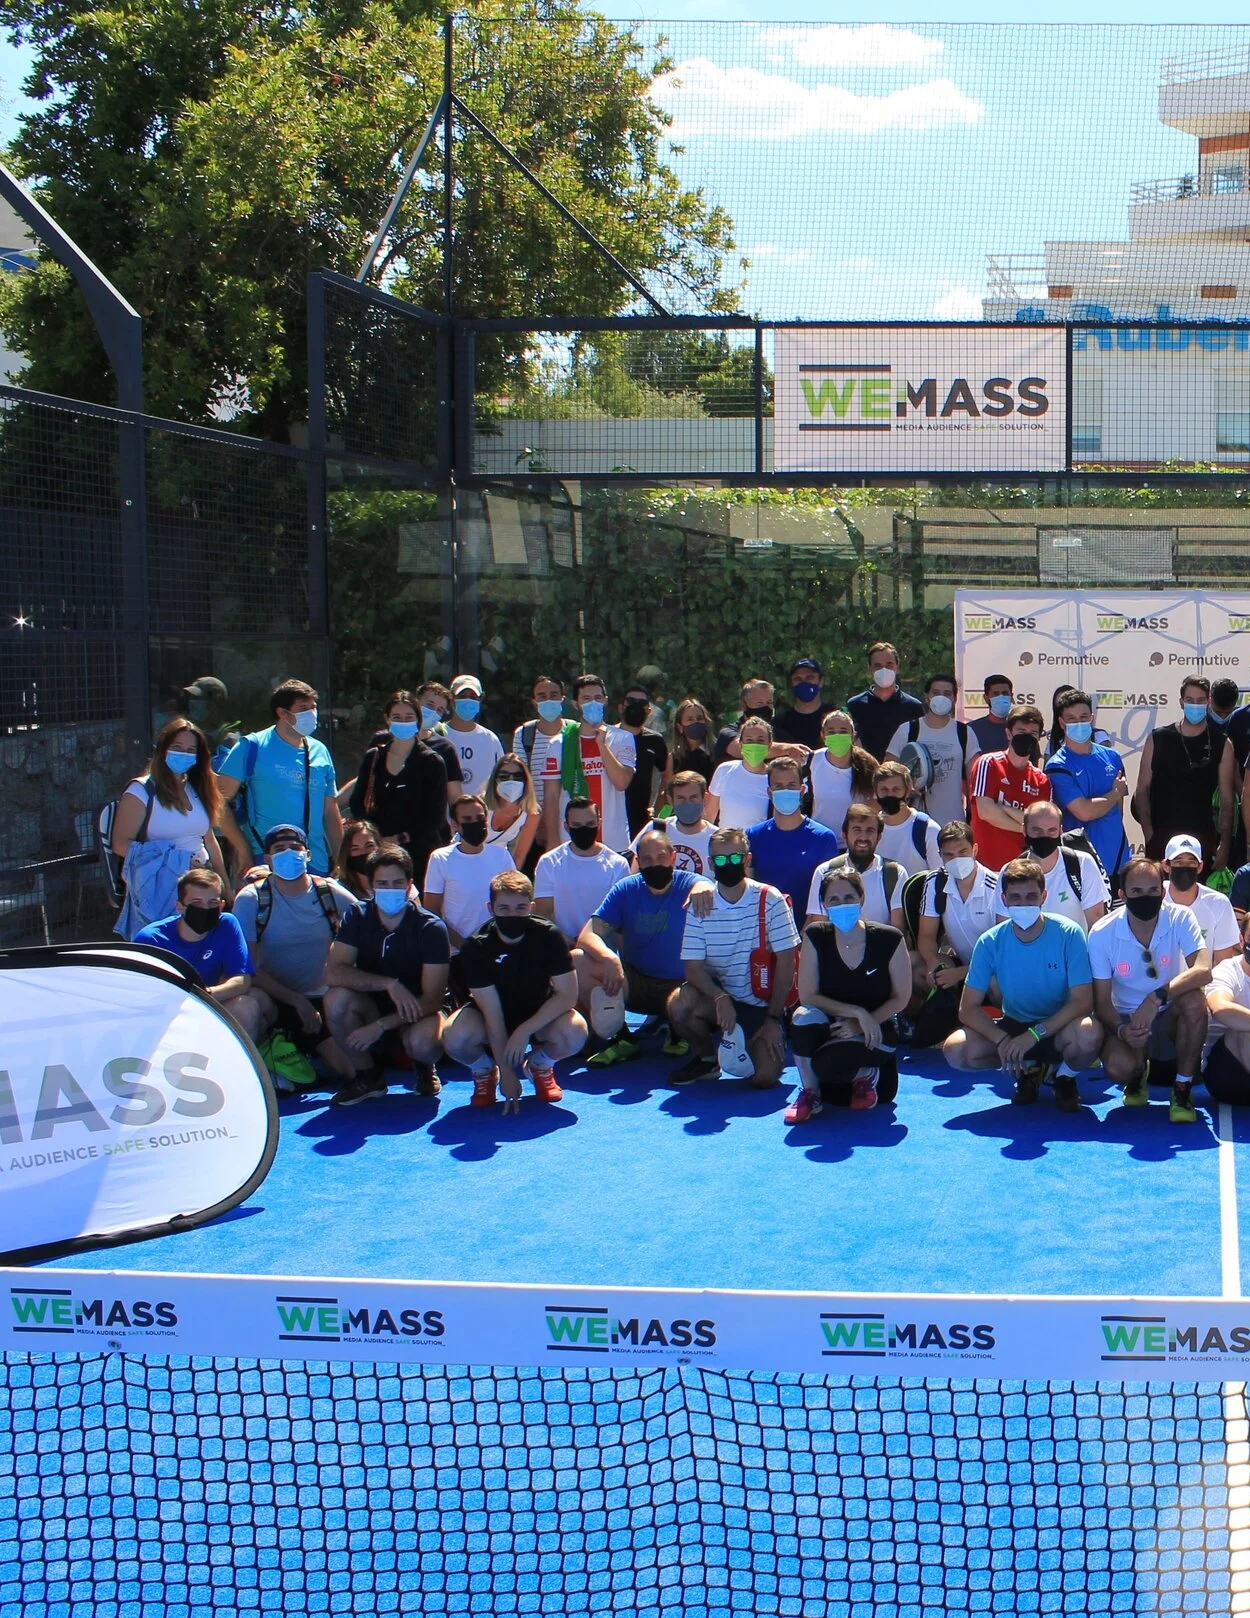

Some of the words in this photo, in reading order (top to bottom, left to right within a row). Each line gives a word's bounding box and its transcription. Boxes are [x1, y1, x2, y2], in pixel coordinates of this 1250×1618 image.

[1038, 652, 1110, 666] Permutive
[1168, 654, 1240, 666] Permutive
[460, 746, 473, 760] 10
[10, 1145, 98, 1171] AUDIENCE
[103, 1138, 145, 1156] SAFE
